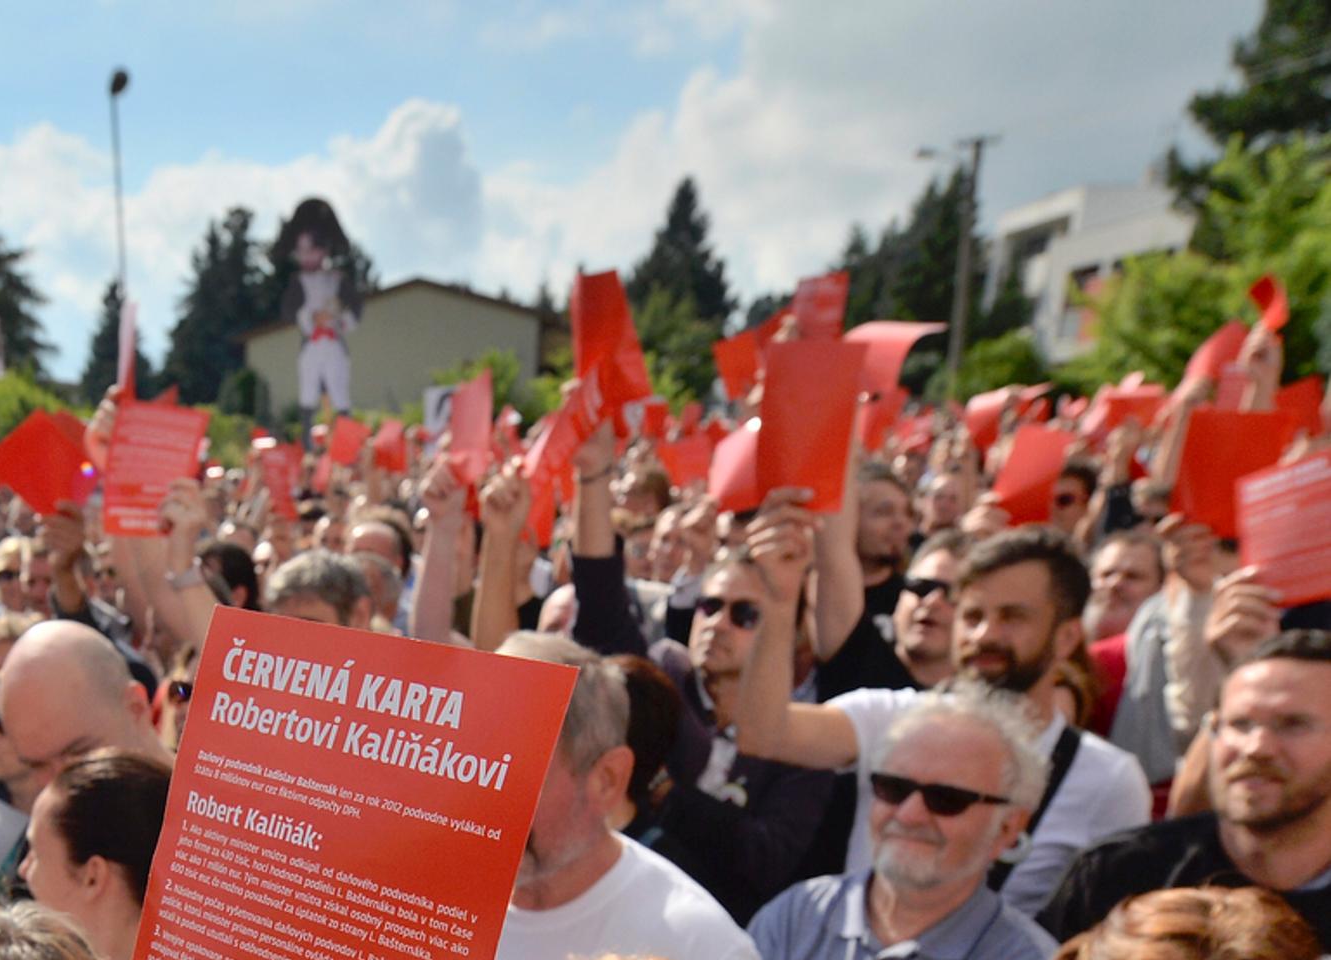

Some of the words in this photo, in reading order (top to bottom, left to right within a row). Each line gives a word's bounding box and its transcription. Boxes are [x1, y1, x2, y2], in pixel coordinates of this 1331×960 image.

[222, 637, 356, 704] ČERVENÁ
[357, 673, 465, 730] KARTA
[209, 692, 341, 750] Robertovi
[343, 720, 513, 791] Kaliňákovi
[186, 791, 243, 829] Robert
[244, 806, 324, 852] Kaliňák:
